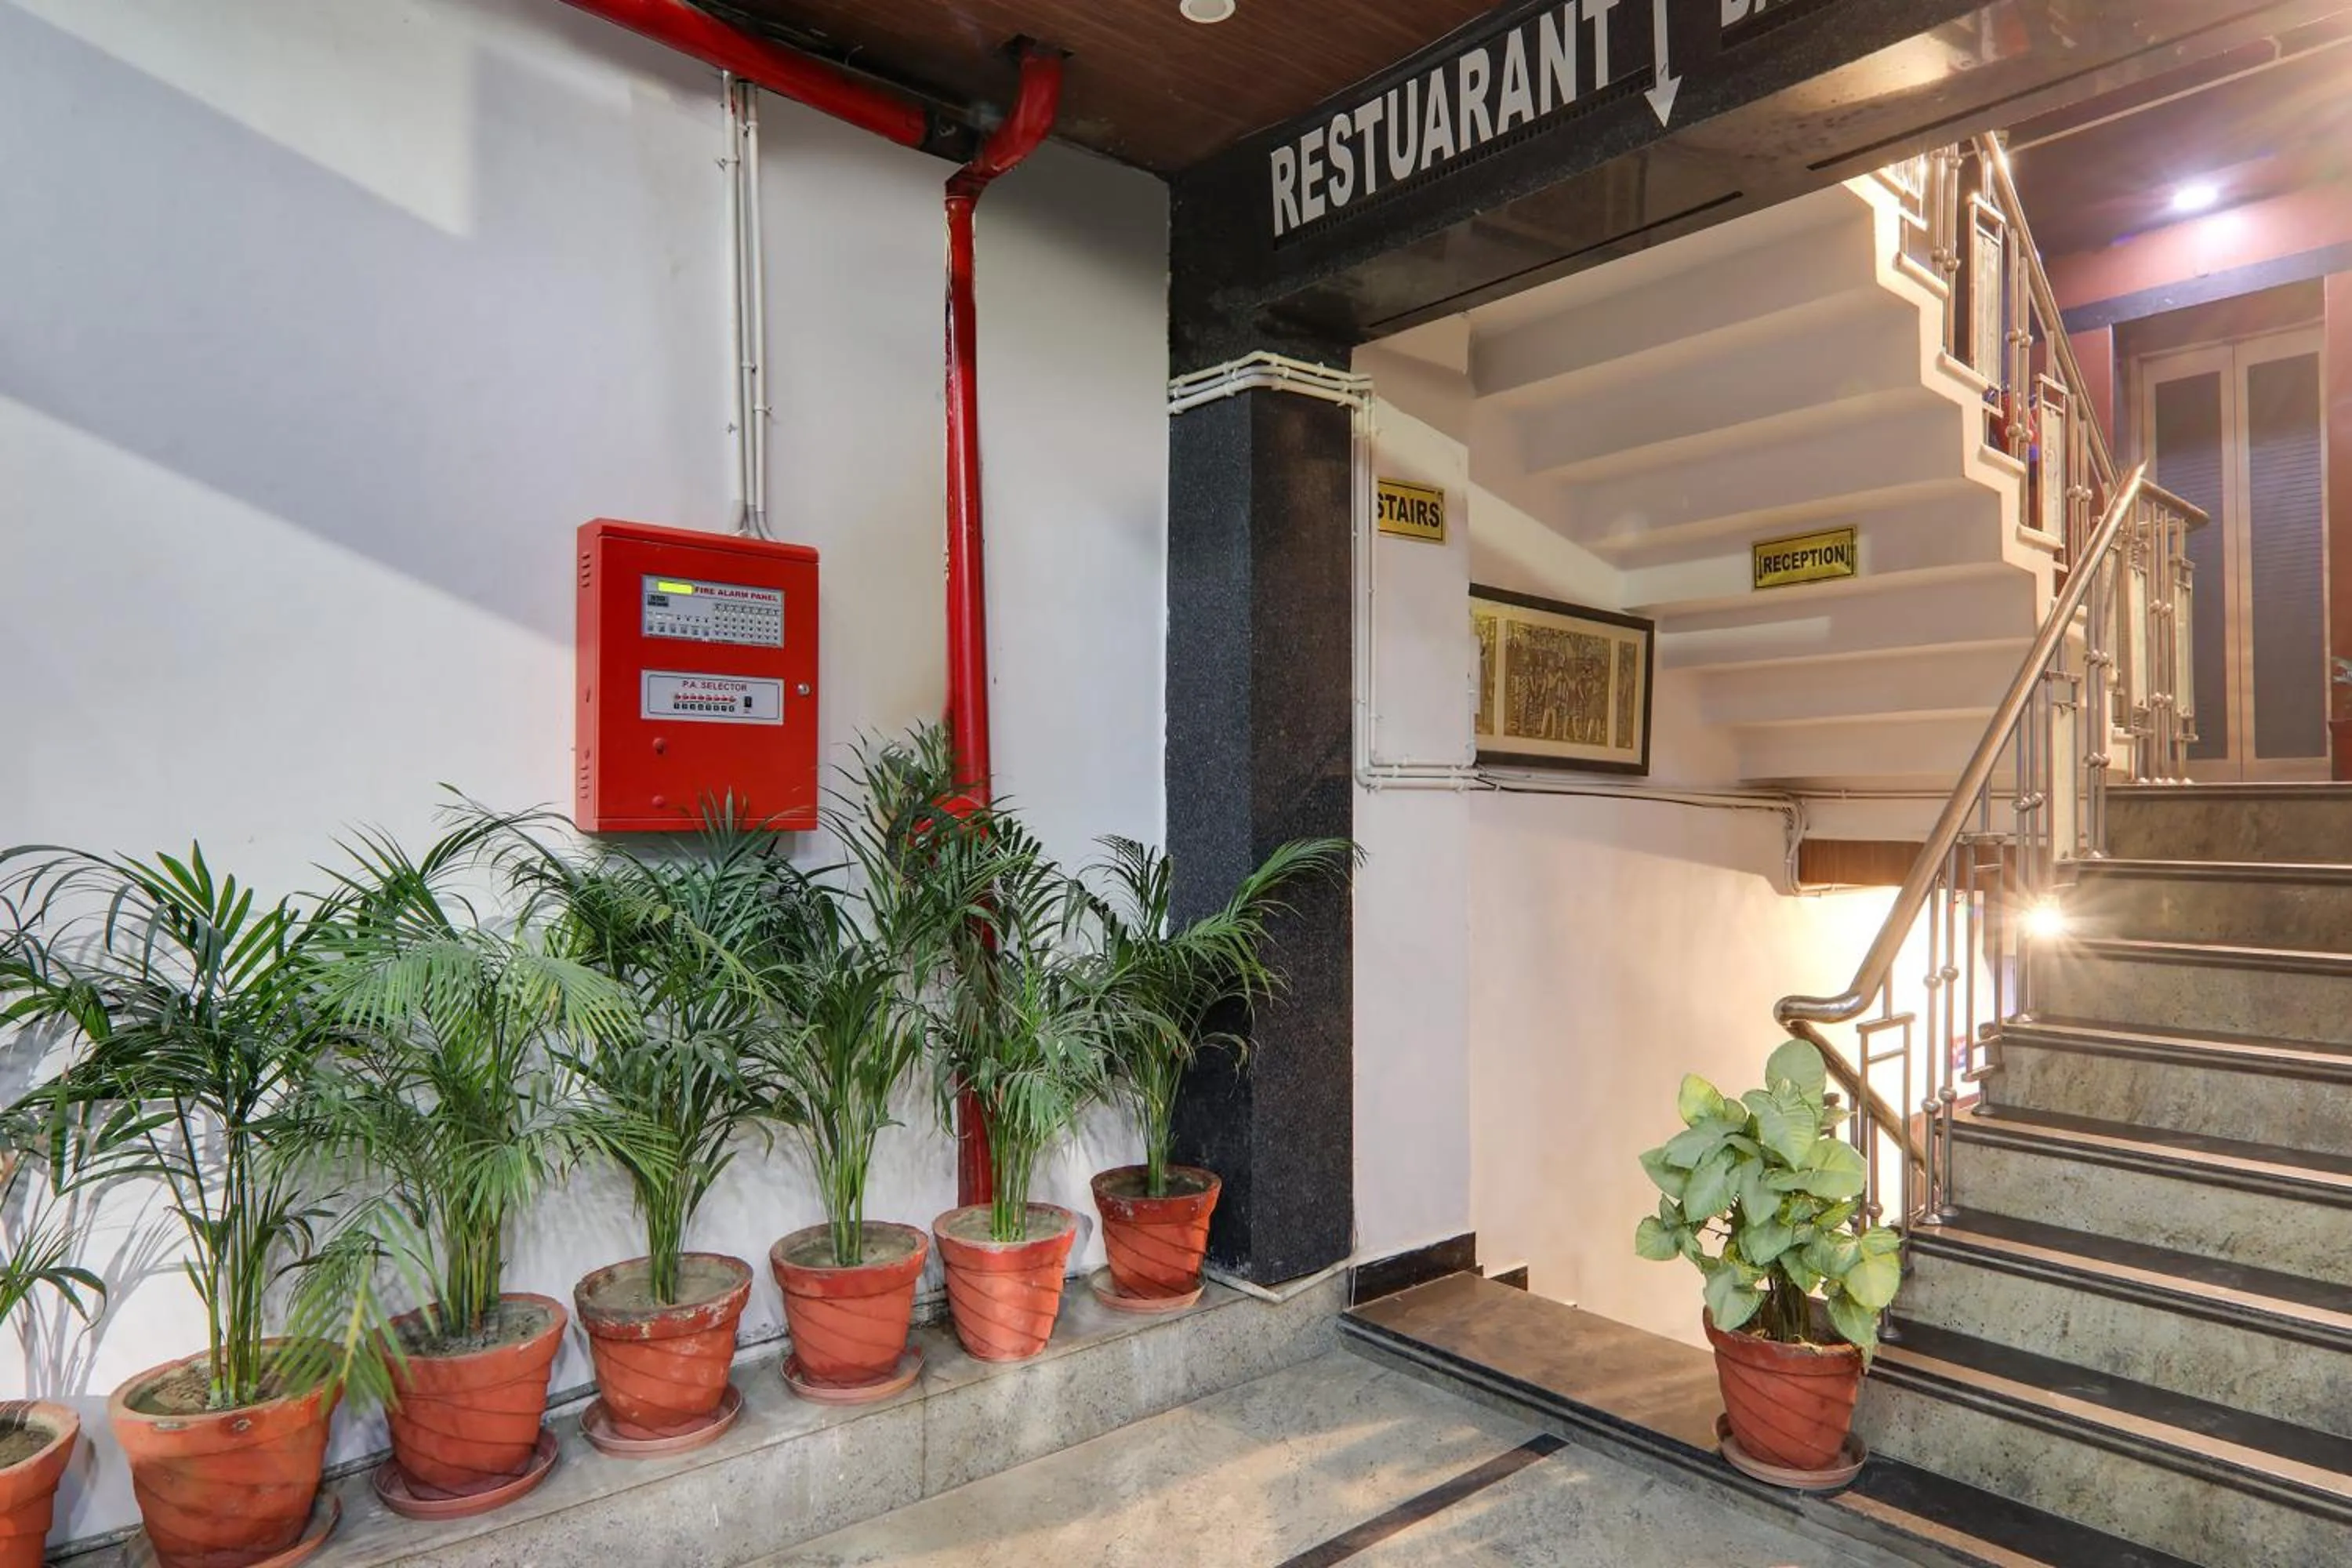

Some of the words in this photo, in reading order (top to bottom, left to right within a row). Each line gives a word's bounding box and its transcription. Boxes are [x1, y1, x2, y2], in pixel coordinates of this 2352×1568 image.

[1270, 0, 1621, 238] RESTUARANT
[1763, 543, 1845, 574] RECEPTION
[695, 586, 715, 595] FIRE
[717, 589, 748, 598] ALARM
[701, 681, 747, 691] SELECTOR
